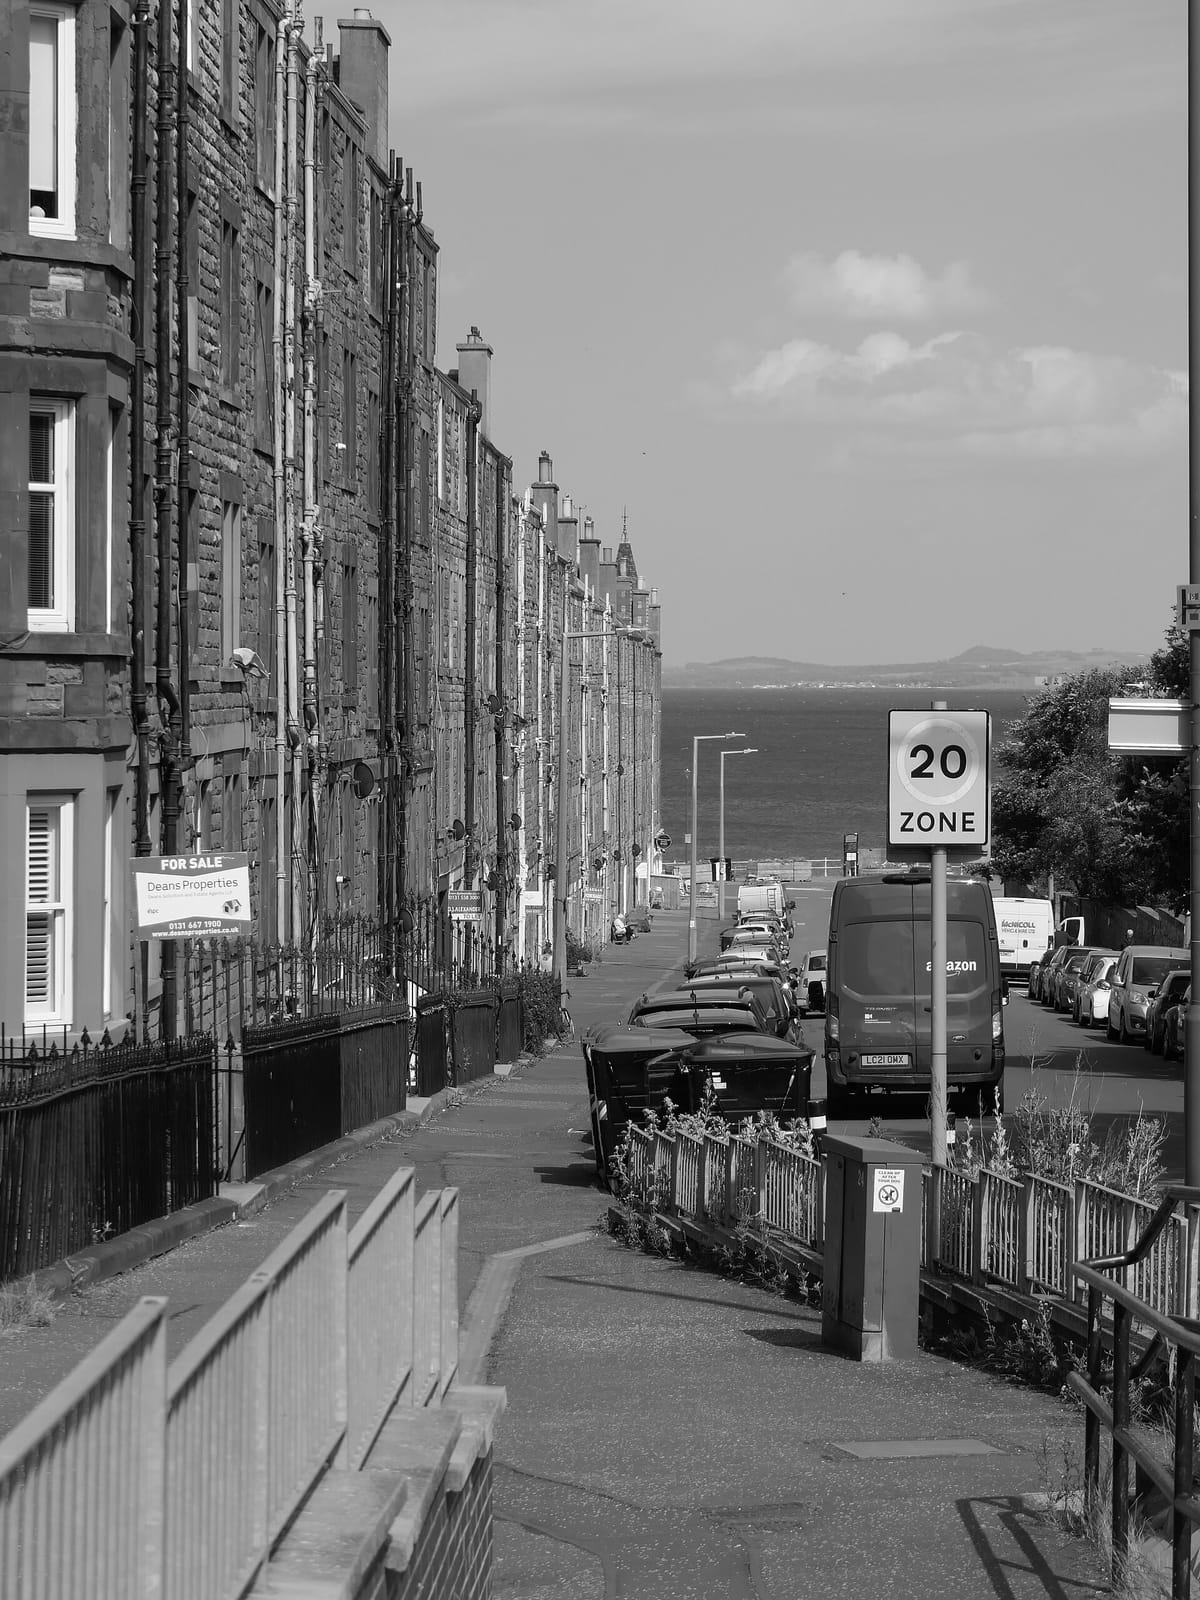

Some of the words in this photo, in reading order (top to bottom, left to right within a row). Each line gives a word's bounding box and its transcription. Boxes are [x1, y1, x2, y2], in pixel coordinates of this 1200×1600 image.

[910, 744, 967, 779] 20
[900, 811, 975, 832] ZONE
[161, 858, 187, 870] FOR
[189, 856, 223, 869] SALE
[148, 882, 181, 891] Deans
[182, 878, 239, 891] Properties
[169, 922, 186, 930] 0131
[188, 921, 202, 929] 667
[204, 920, 222, 928] 1900
[152, 926, 239, 937] www.deansproperties.co.uk
[926, 960, 977, 971] aazon
[866, 1055, 886, 1064] LC21
